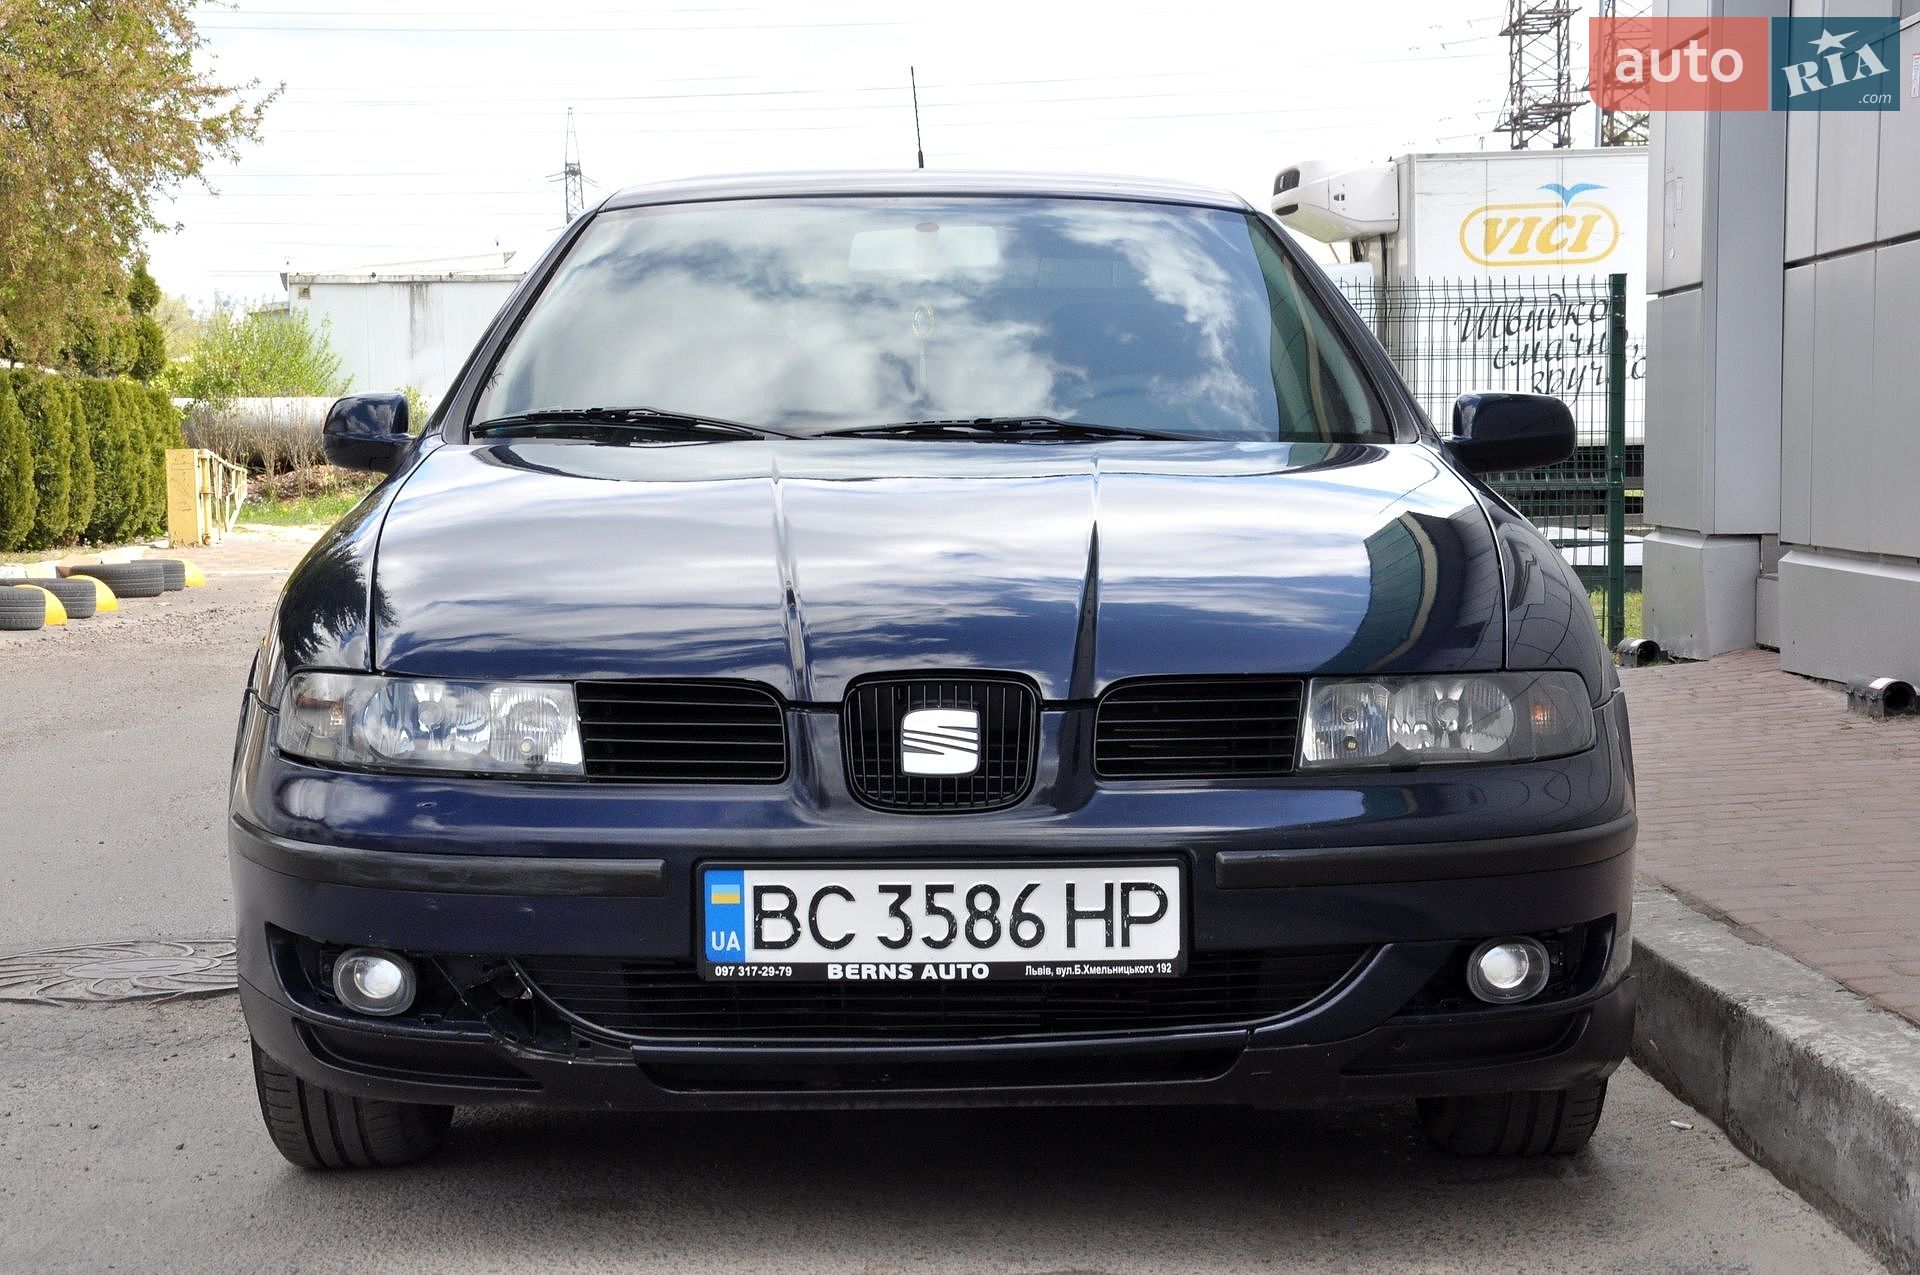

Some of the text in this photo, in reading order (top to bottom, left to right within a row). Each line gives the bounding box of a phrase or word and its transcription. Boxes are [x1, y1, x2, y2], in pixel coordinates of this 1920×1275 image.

[1483, 214, 1602, 256] VICI
[752, 882, 1169, 950] BC 3586 HP
[711, 932, 741, 951] UA
[714, 966, 792, 977] 097 317-29-79
[827, 963, 990, 980] BERNS AUTO
[1156, 962, 1172, 974] 192
